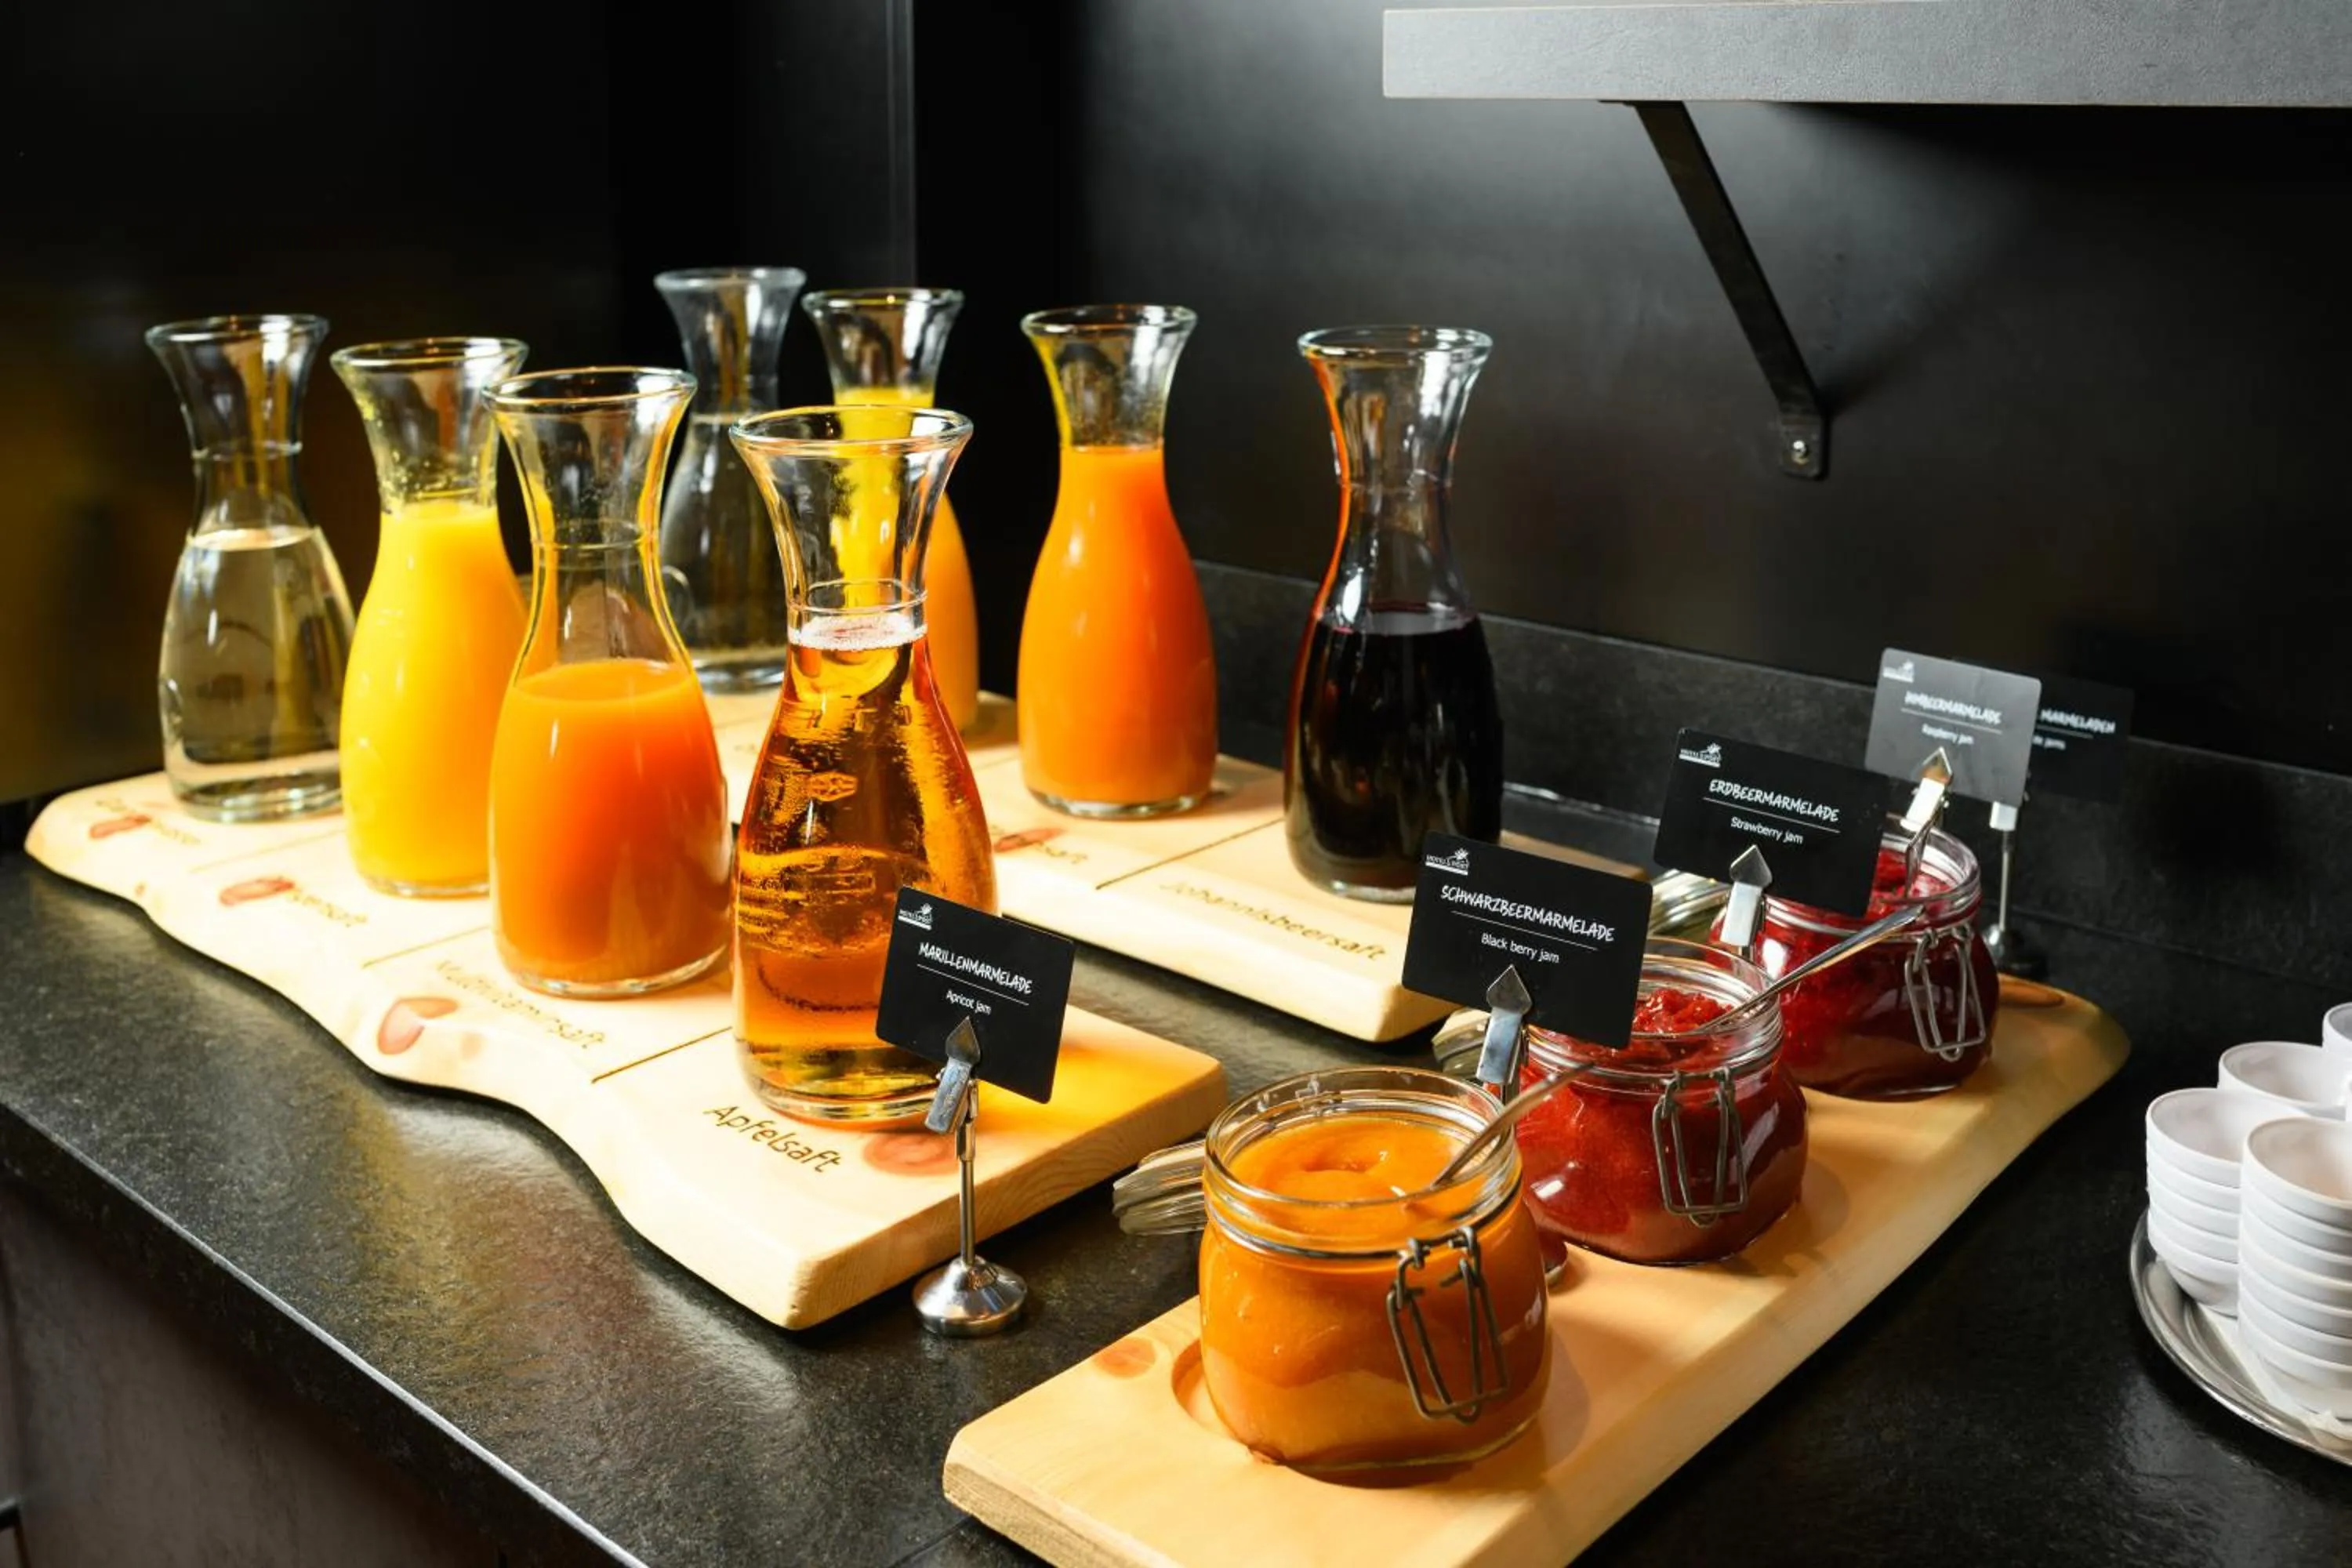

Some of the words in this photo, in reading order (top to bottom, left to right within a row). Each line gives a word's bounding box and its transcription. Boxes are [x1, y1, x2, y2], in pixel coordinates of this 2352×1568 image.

[1709, 779, 1839, 822] ERDBEERMARMELADE
[1730, 816, 1782, 841] Strawberry
[1783, 829, 1804, 845] jam
[1440, 884, 1616, 942] SCHWARZBEERMARMELADE
[918, 942, 1033, 995] MARILLENMARMELADE
[1481, 932, 1508, 949] Black
[1510, 939, 1537, 962] berry
[1538, 949, 1560, 964] jam
[946, 989, 975, 1010] Apricot
[975, 999, 992, 1015] jam
[702, 1104, 841, 1174] Apfelsaft
